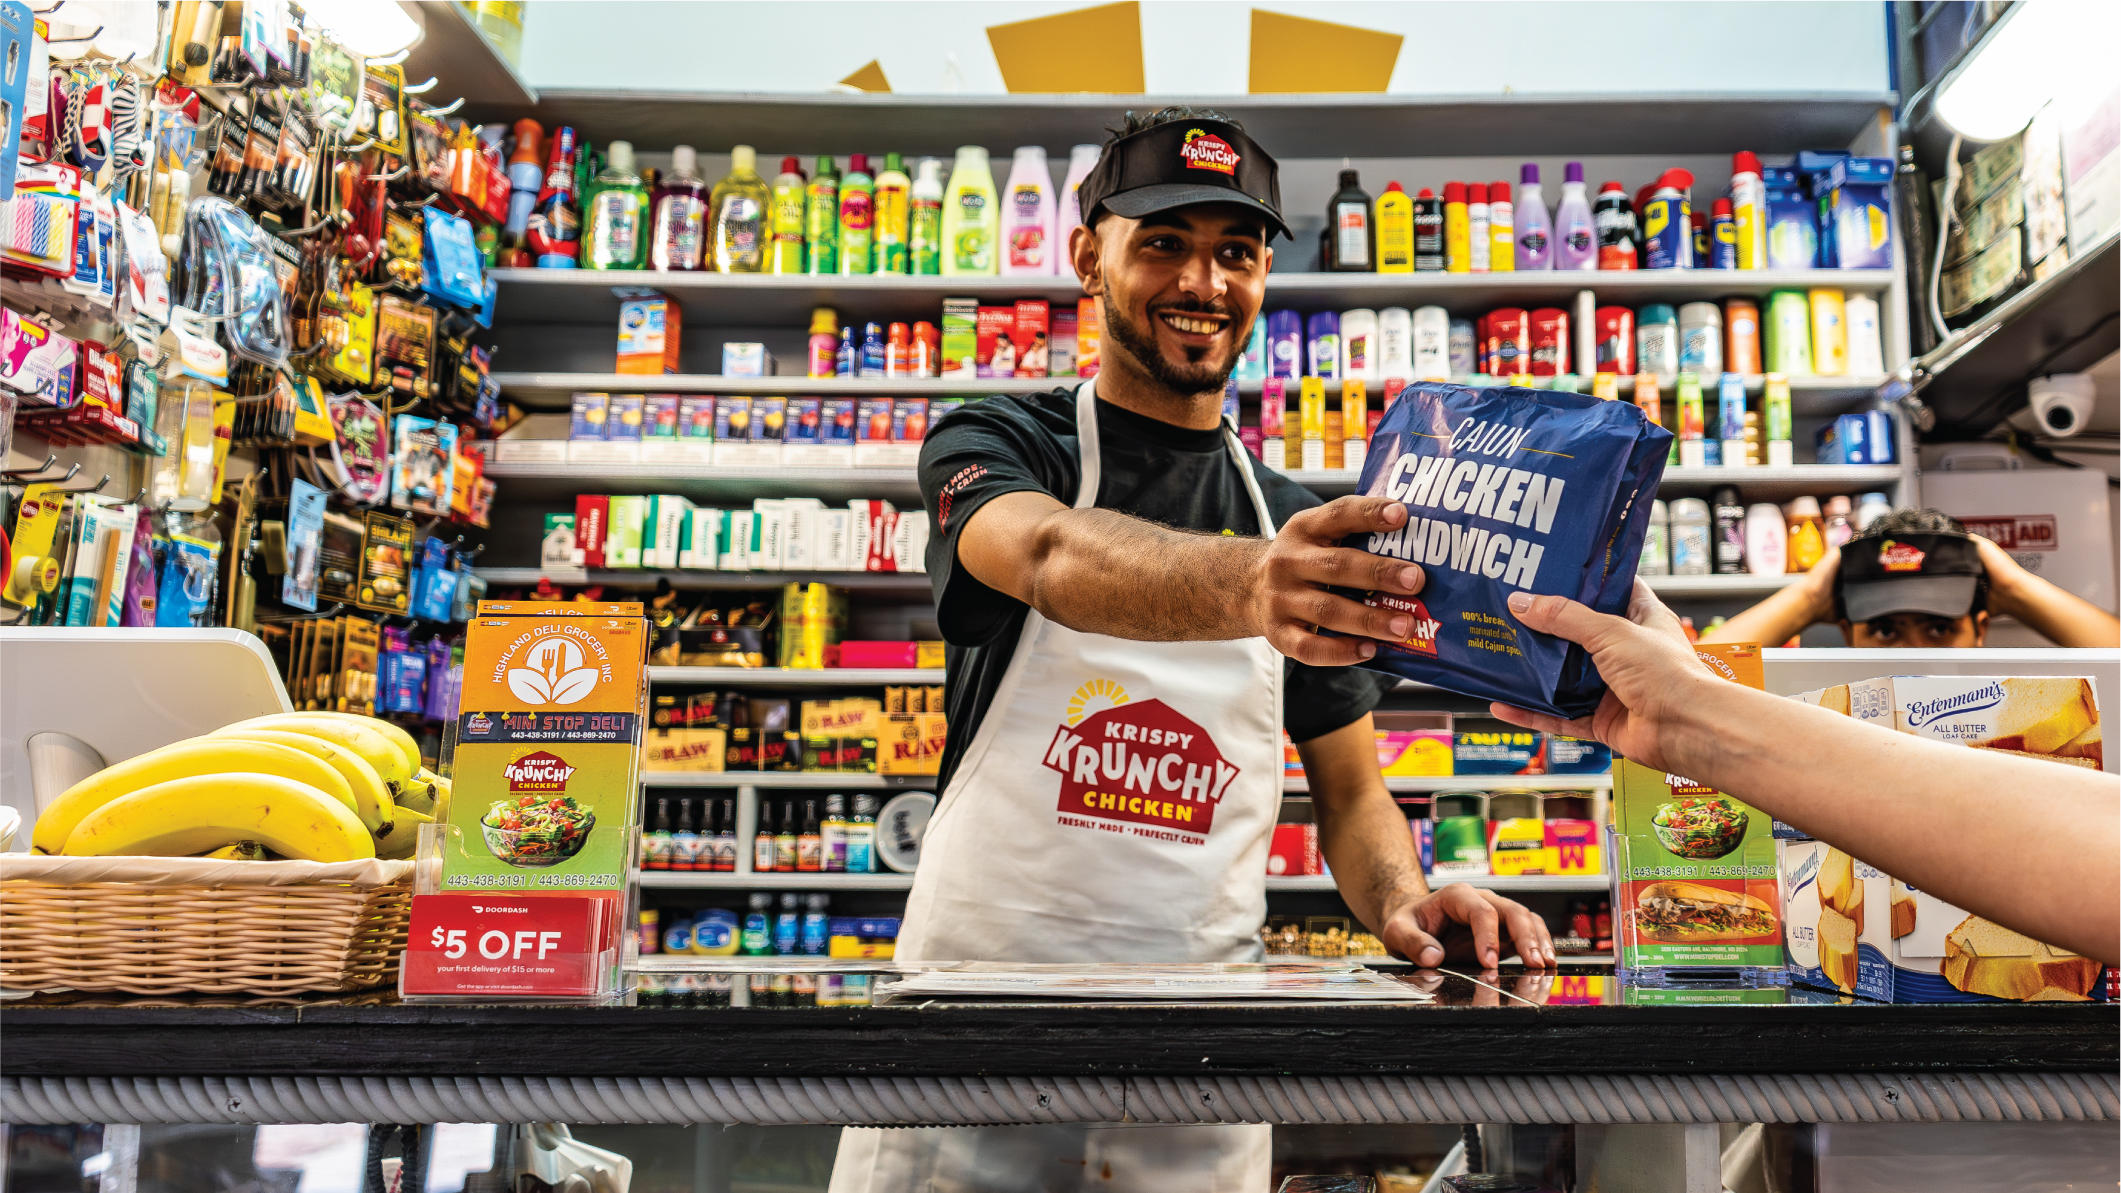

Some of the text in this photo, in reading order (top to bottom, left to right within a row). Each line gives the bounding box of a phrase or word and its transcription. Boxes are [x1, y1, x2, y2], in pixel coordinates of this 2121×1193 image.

[1181, 143, 1241, 166] KRUNCHY
[1448, 417, 1532, 460] CAJUN
[1386, 453, 1566, 535] CHICKEN
[2019, 525, 2051, 541] AID
[1368, 516, 1545, 590] SANDWICH
[1382, 596, 1418, 613] KRISPY
[1462, 611, 1483, 623] 100%
[492, 624, 613, 684] HIGHLAND DELI GROCERY INC
[1468, 637, 1484, 649] mild
[1485, 640, 1505, 654] Cajun
[1906, 681, 2003, 727] Entenmann's
[504, 715, 626, 731] MINI STOP DELI
[822, 711, 865, 729] RAW
[1933, 724, 1987, 733] ALL BUTTER
[511, 731, 560, 739] 443-438-3191
[1105, 721, 1194, 750] KRISPY
[504, 764, 577, 783] KRUNCHY
[1046, 728, 1238, 804] KRUNCHY
[1665, 773, 1699, 788] KRUN
[1083, 791, 1193, 823] CHICKEN
[1057, 816, 1206, 846] FRESHLY MADE PERFECTLY CAJUN
[448, 874, 526, 886] 443-438-3191
[538, 874, 617, 887] 443-869-2470
[485, 906, 528, 914] DOORDASH
[431, 926, 562, 960] $5 OFF
[437, 965, 455, 974] your
[455, 965, 470, 973] first
[471, 965, 502, 974] delivery
